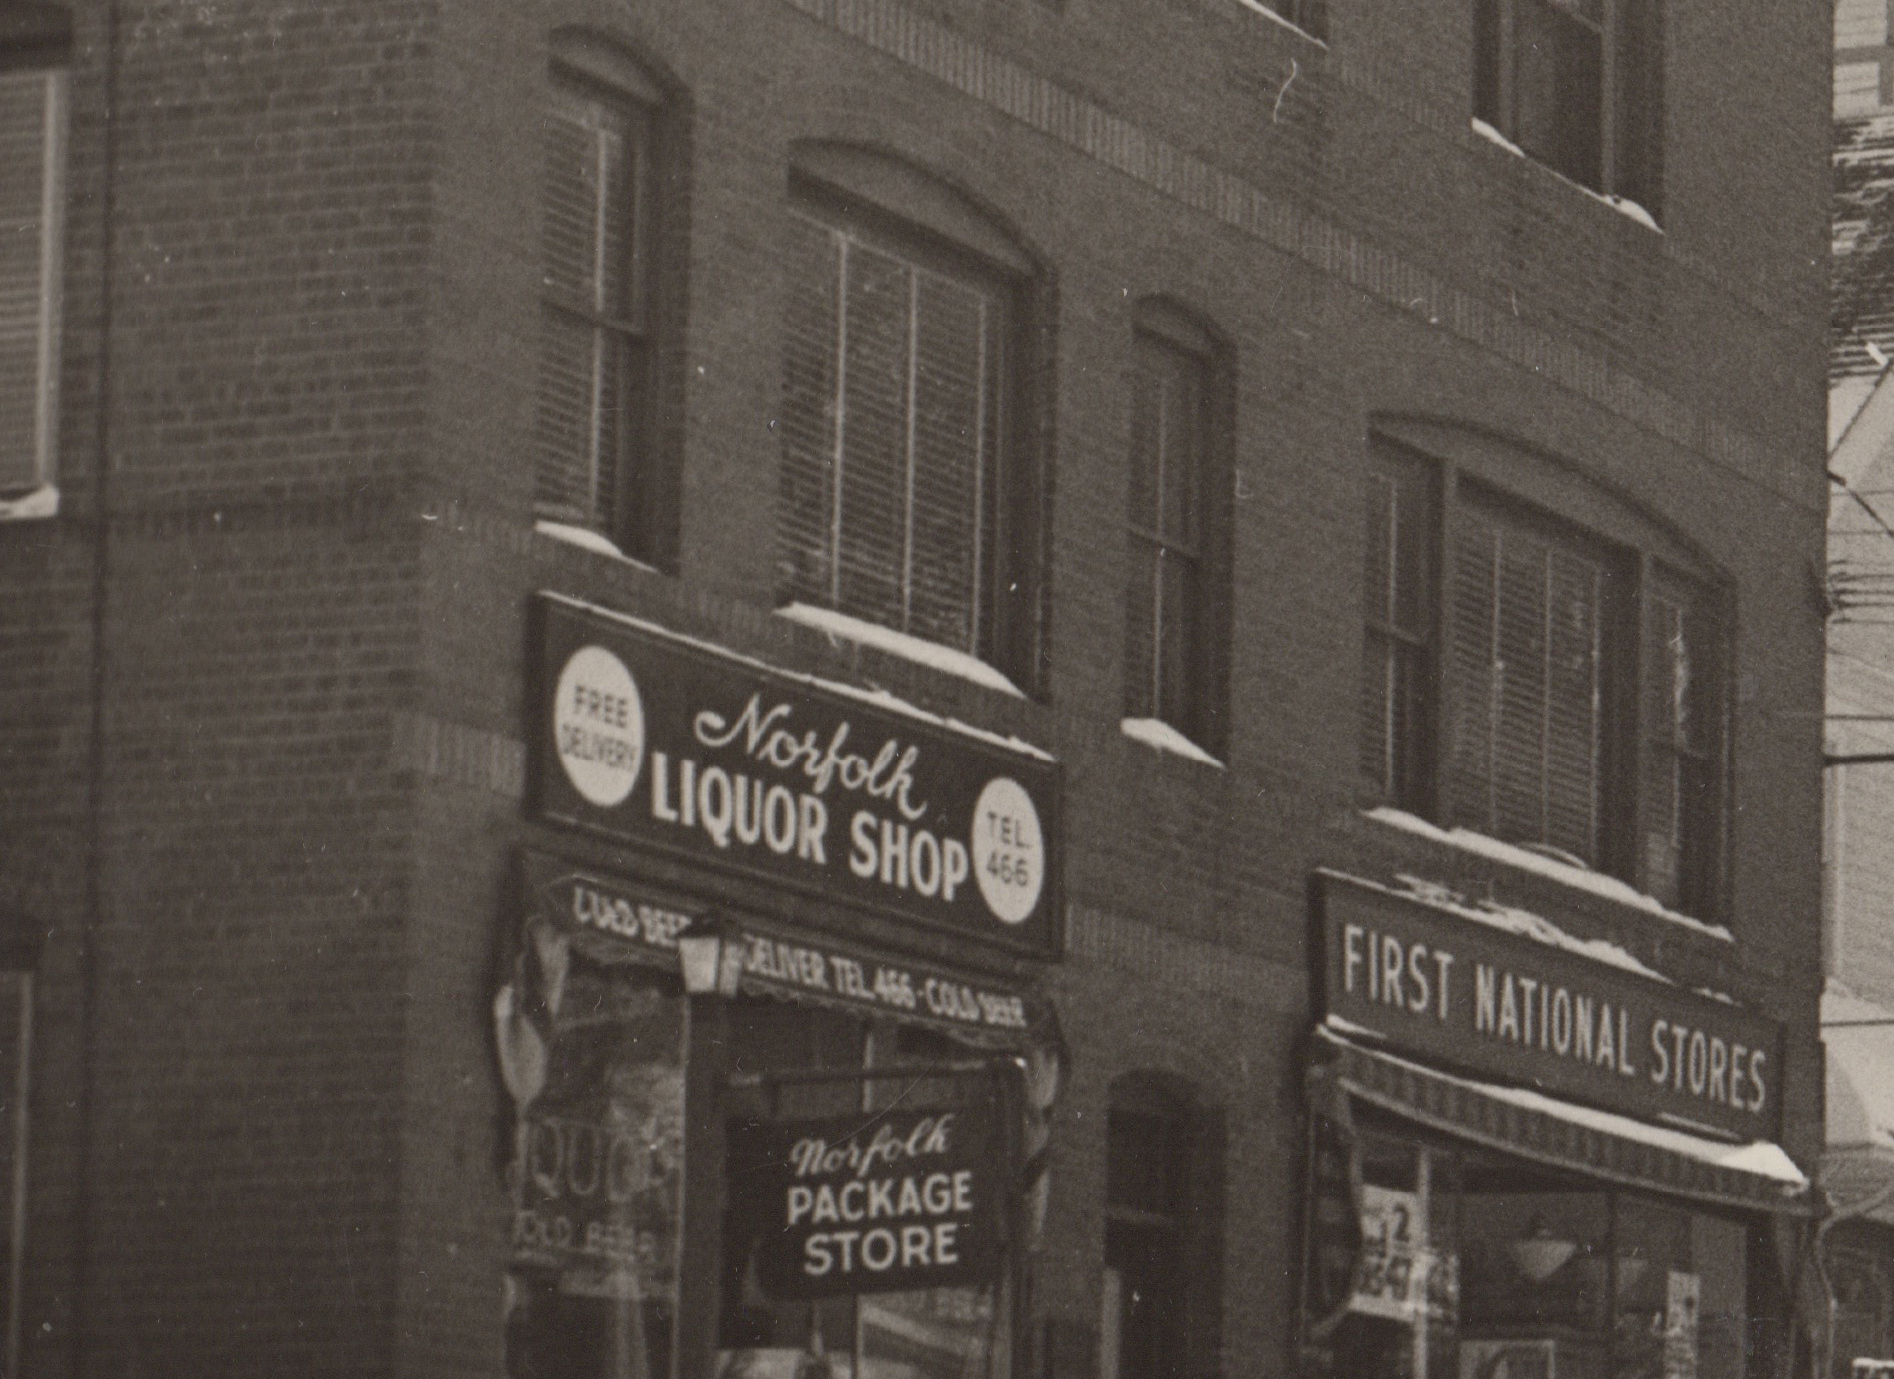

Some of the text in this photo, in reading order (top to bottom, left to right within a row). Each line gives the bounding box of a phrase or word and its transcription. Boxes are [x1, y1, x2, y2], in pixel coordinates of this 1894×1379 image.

[575, 684, 628, 729] FREE
[561, 723, 638, 773] DELIVERY
[693, 693, 927, 820] Norfolk
[651, 750, 969, 902] LIQUOR SHOP
[986, 850, 1030, 888] 466
[925, 977, 980, 1022] COLD
[1344, 924, 1767, 1113] FIRST NATIONAL STORES
[789, 1113, 956, 1178] Norfolk
[787, 1170, 973, 1226] PACKAGE
[803, 1223, 959, 1277] STORE
